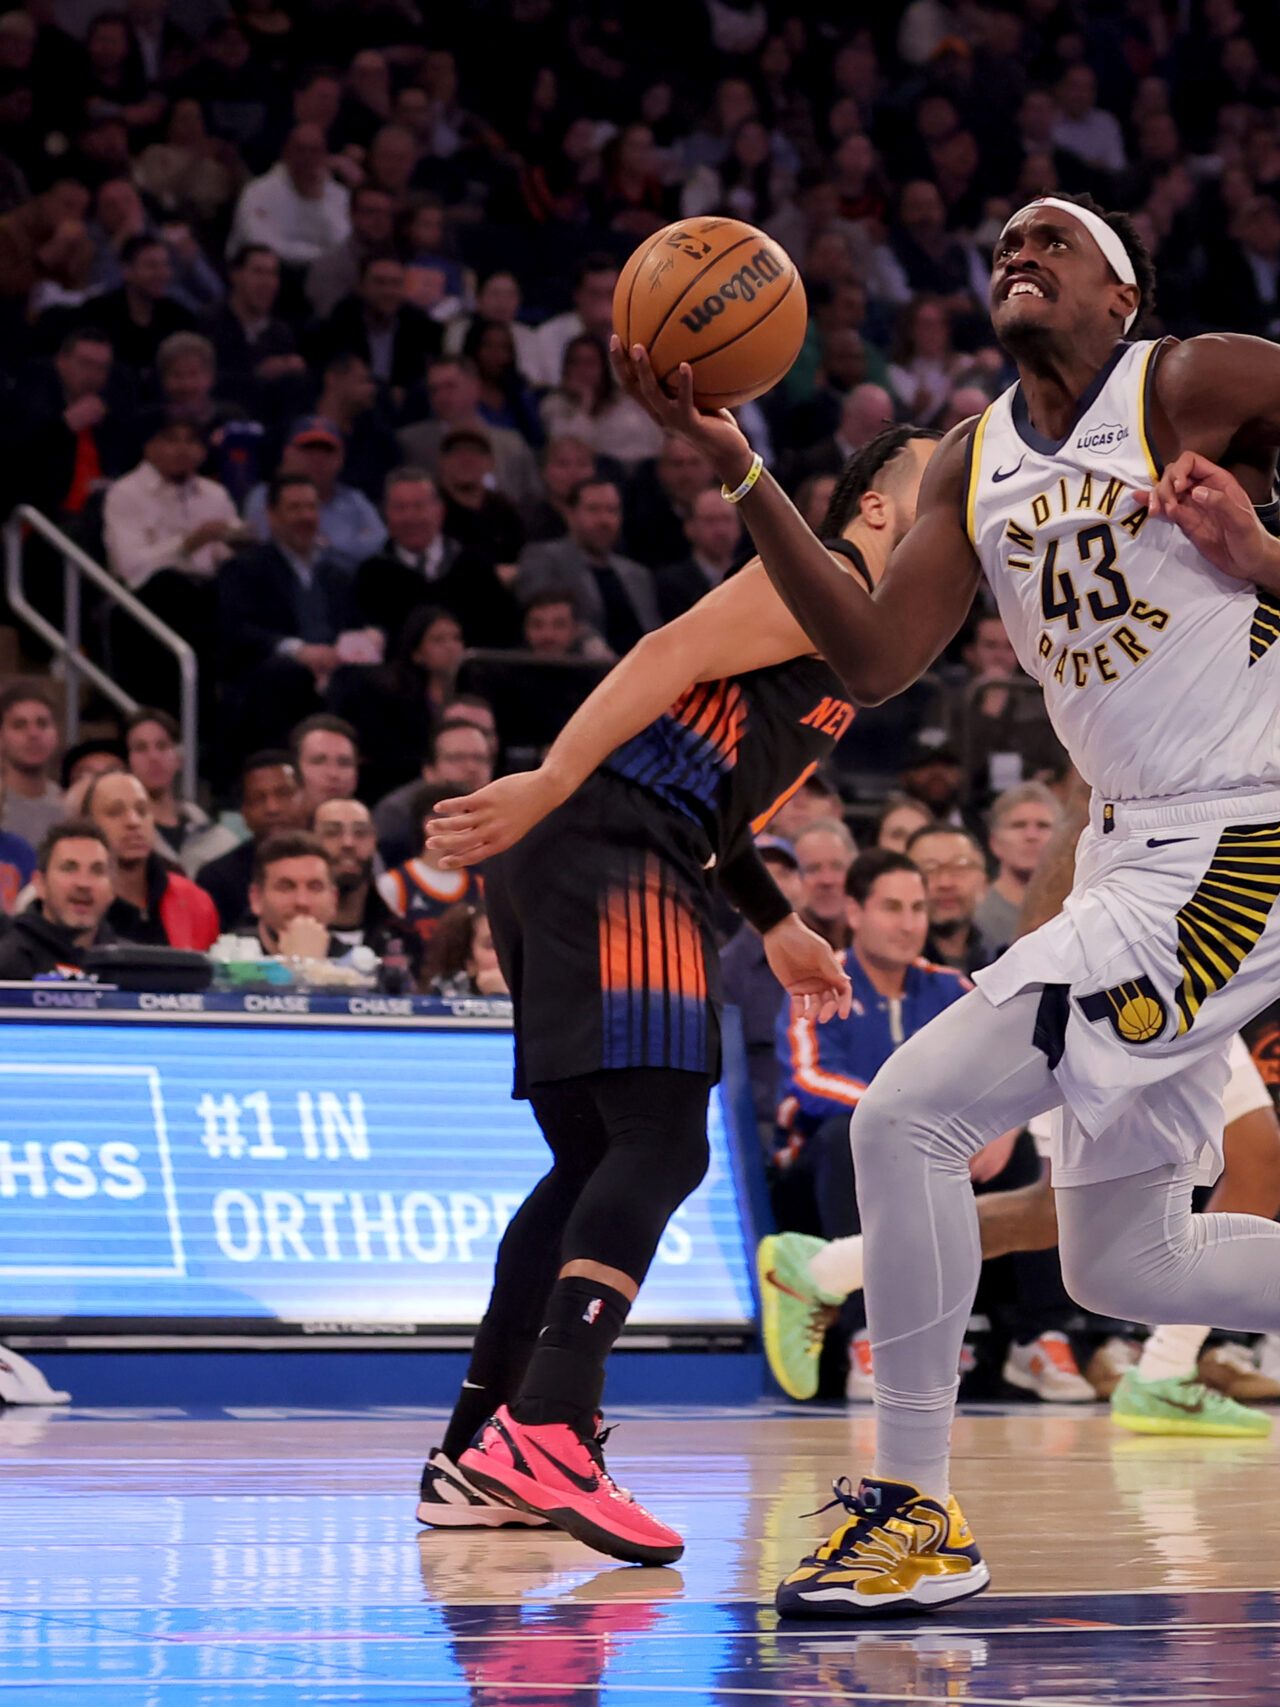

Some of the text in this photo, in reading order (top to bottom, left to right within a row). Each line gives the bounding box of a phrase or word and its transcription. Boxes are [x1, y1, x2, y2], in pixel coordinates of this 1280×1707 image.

[680, 249, 784, 333] Wilson
[1077, 432, 1114, 449] LUCAS
[1007, 470, 1149, 573] INDIANA
[1041, 523, 1132, 631] 43
[1038, 599, 1170, 689] PACERS
[32, 990, 97, 1008] CHASE
[138, 993, 204, 1011] CHASE
[244, 994, 309, 1012] CHASE
[349, 998, 414, 1015] CHASE
[196, 1091, 371, 1160] #1 IN
[0, 1140, 147, 1200] HSS
